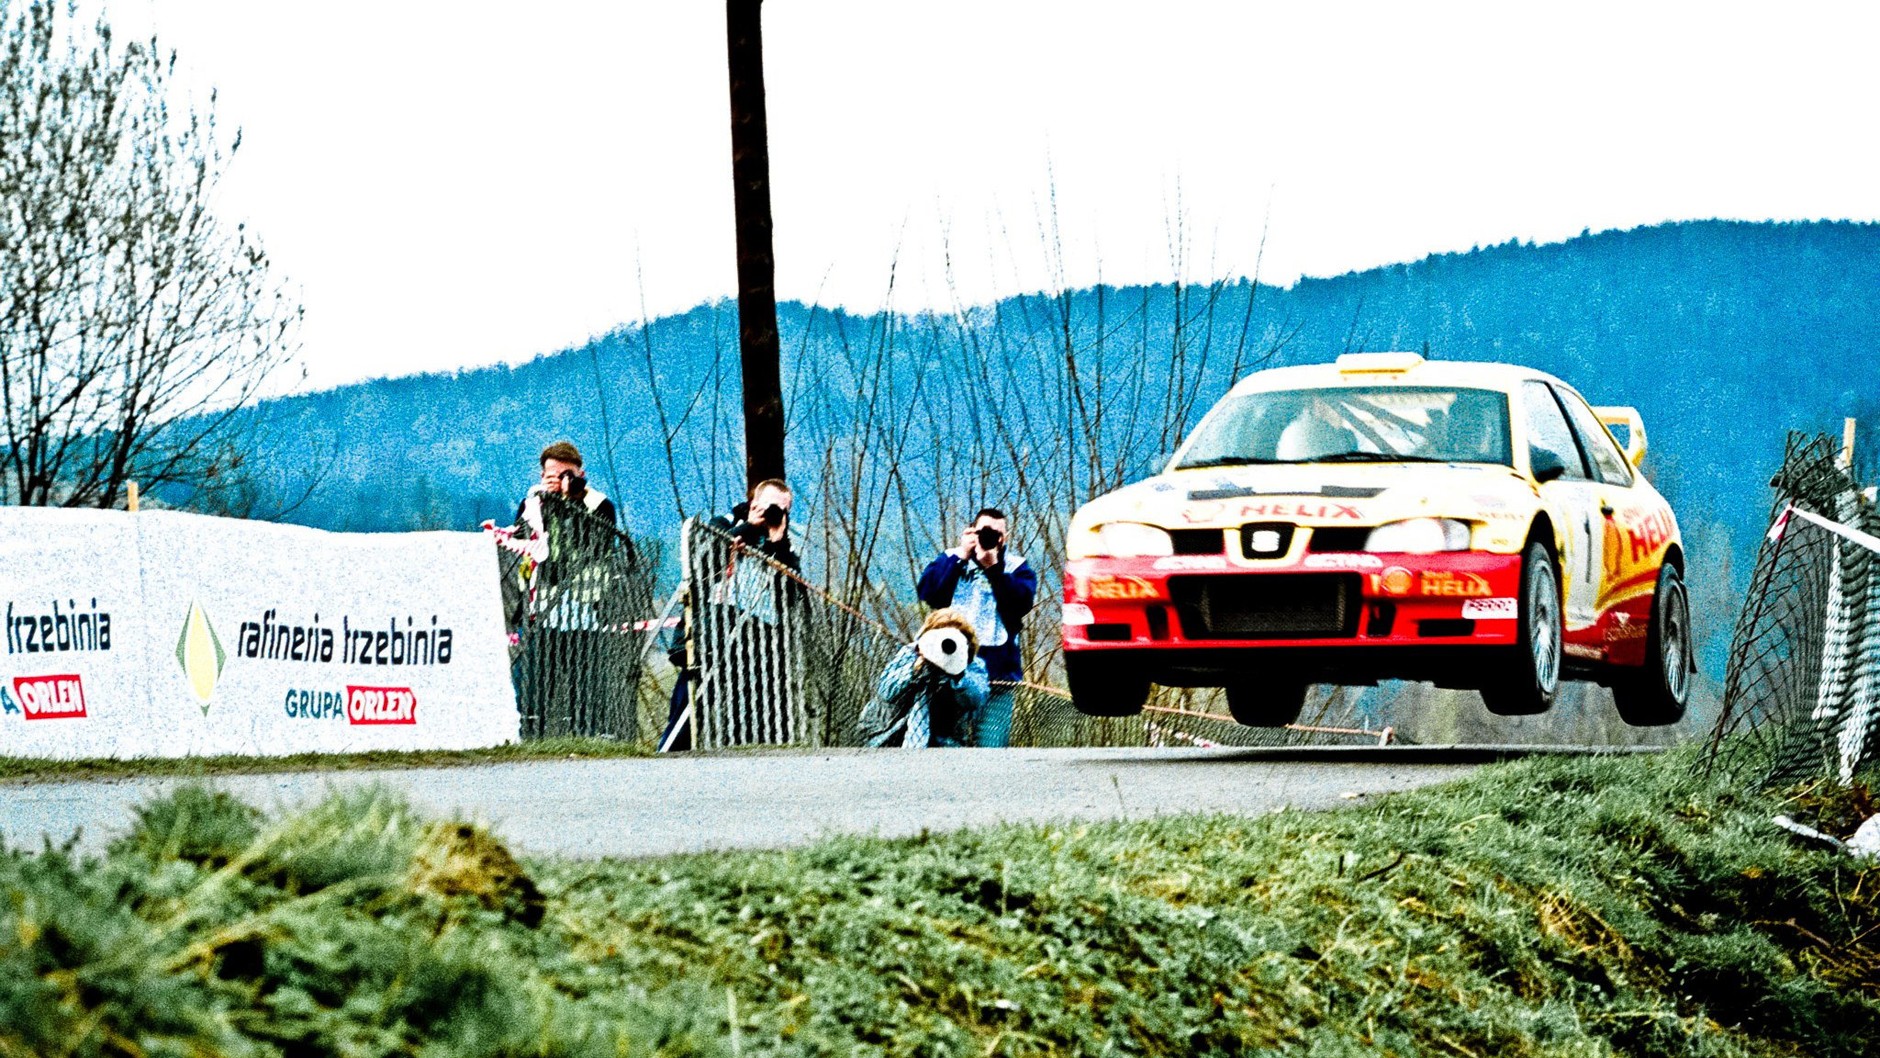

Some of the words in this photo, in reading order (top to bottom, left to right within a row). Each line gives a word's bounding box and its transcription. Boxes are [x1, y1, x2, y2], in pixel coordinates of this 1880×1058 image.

[1421, 576, 1492, 596] HELIX
[7, 597, 111, 654] trzebinia
[237, 608, 334, 662] rafineria
[343, 615, 453, 665] trzebinia
[19, 680, 84, 714] ORLEN
[285, 688, 345, 719] GRUPA
[350, 689, 413, 721] ORLEN
